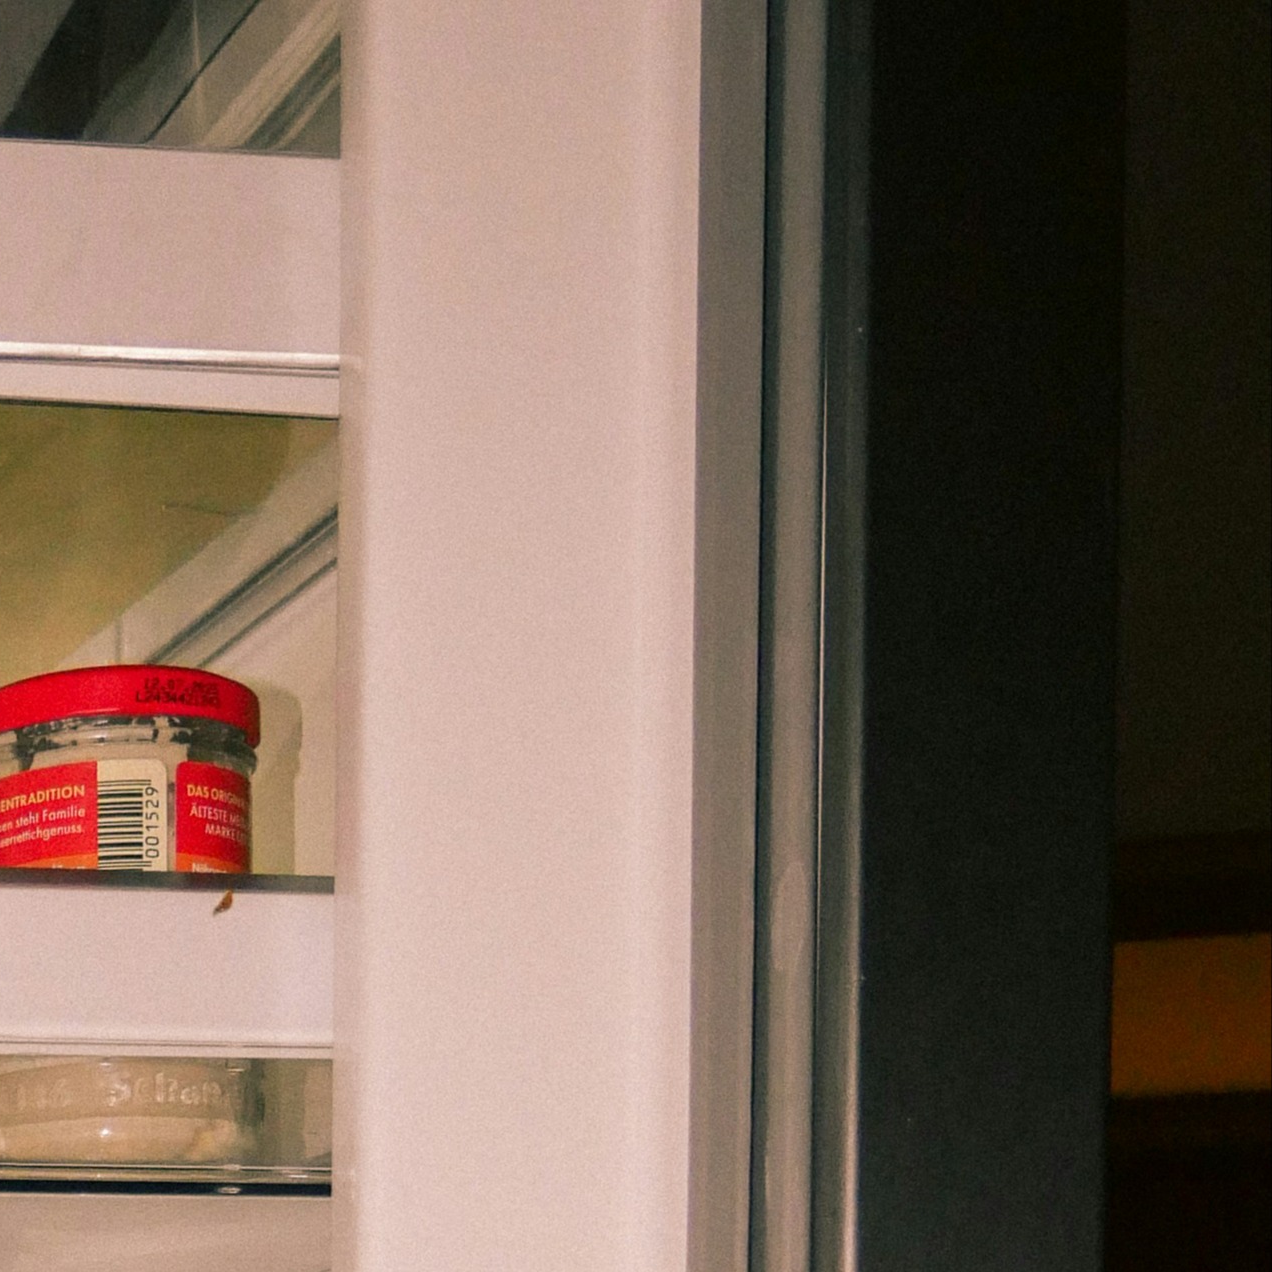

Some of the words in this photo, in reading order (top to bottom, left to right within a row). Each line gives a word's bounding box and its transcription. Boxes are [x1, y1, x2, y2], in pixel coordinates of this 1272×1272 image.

[187, 784, 210, 799] DAS
[15, 811, 39, 828] steht
[42, 805, 85, 822] Familie
[145, 787, 159, 859] 001529
